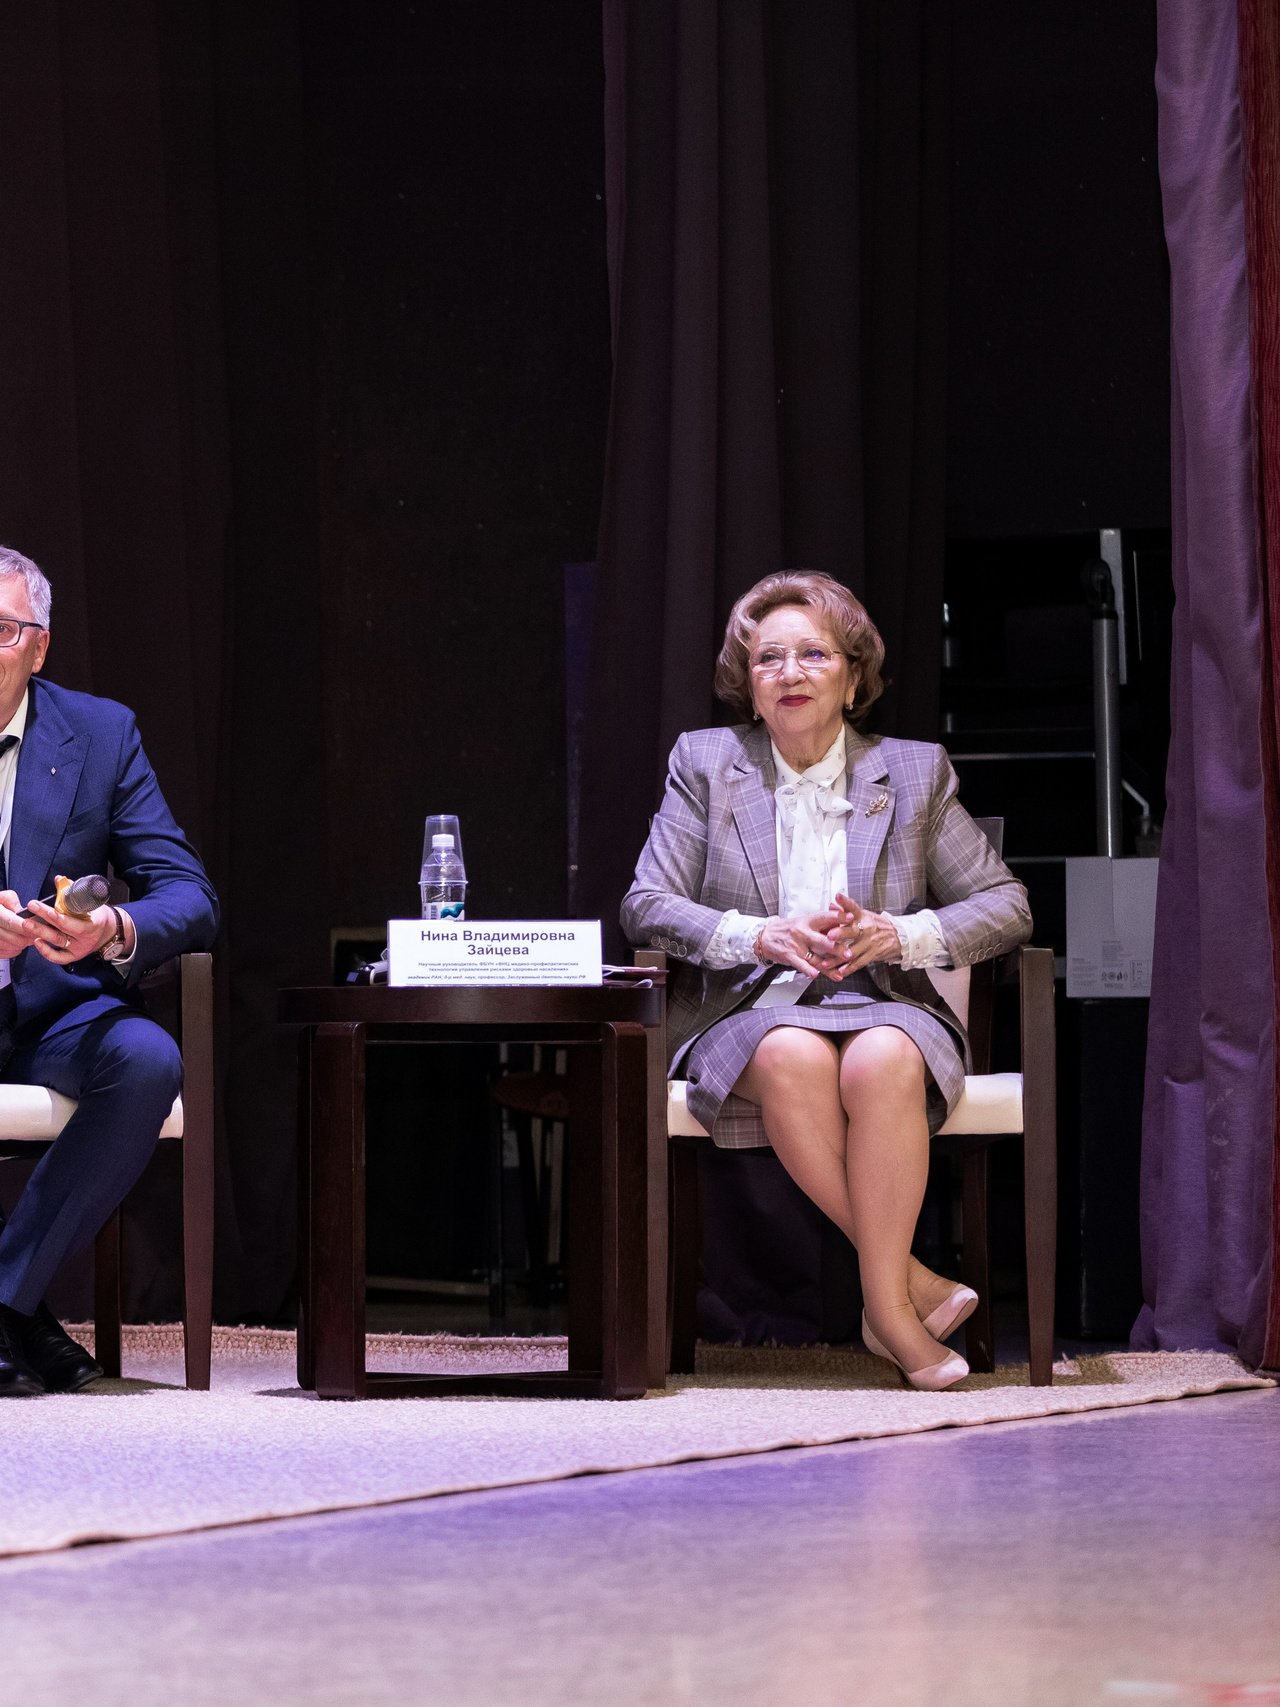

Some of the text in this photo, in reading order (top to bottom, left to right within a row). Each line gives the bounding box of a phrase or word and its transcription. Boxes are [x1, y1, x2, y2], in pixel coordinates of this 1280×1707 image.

[421, 930, 575, 944] Нина Владимировна
[467, 944, 529, 956] Зайцева
